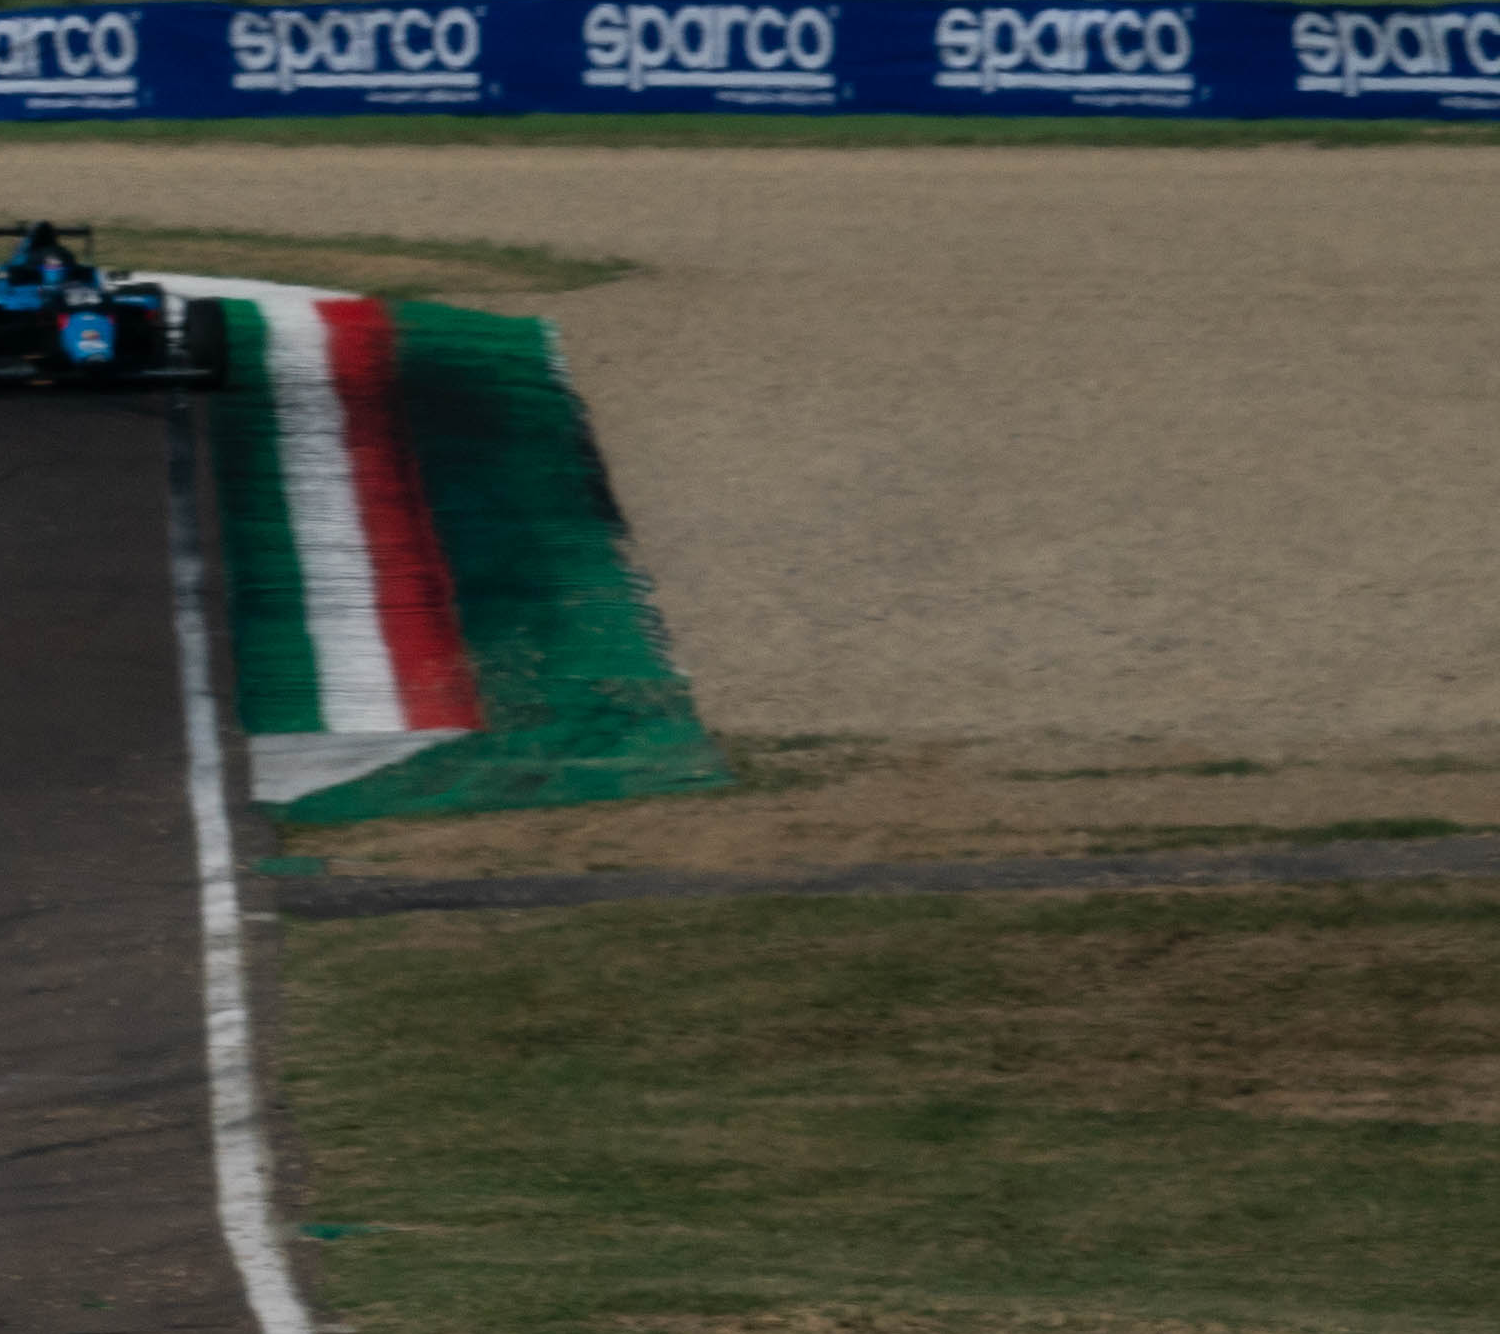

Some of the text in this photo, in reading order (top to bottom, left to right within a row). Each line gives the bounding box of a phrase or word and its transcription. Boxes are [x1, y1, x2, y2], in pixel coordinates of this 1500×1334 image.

[229, 6, 480, 94] sparco
[582, 4, 835, 91] sparco
[935, 6, 1194, 94] sparco
[1292, 11, 1500, 97] sparc
